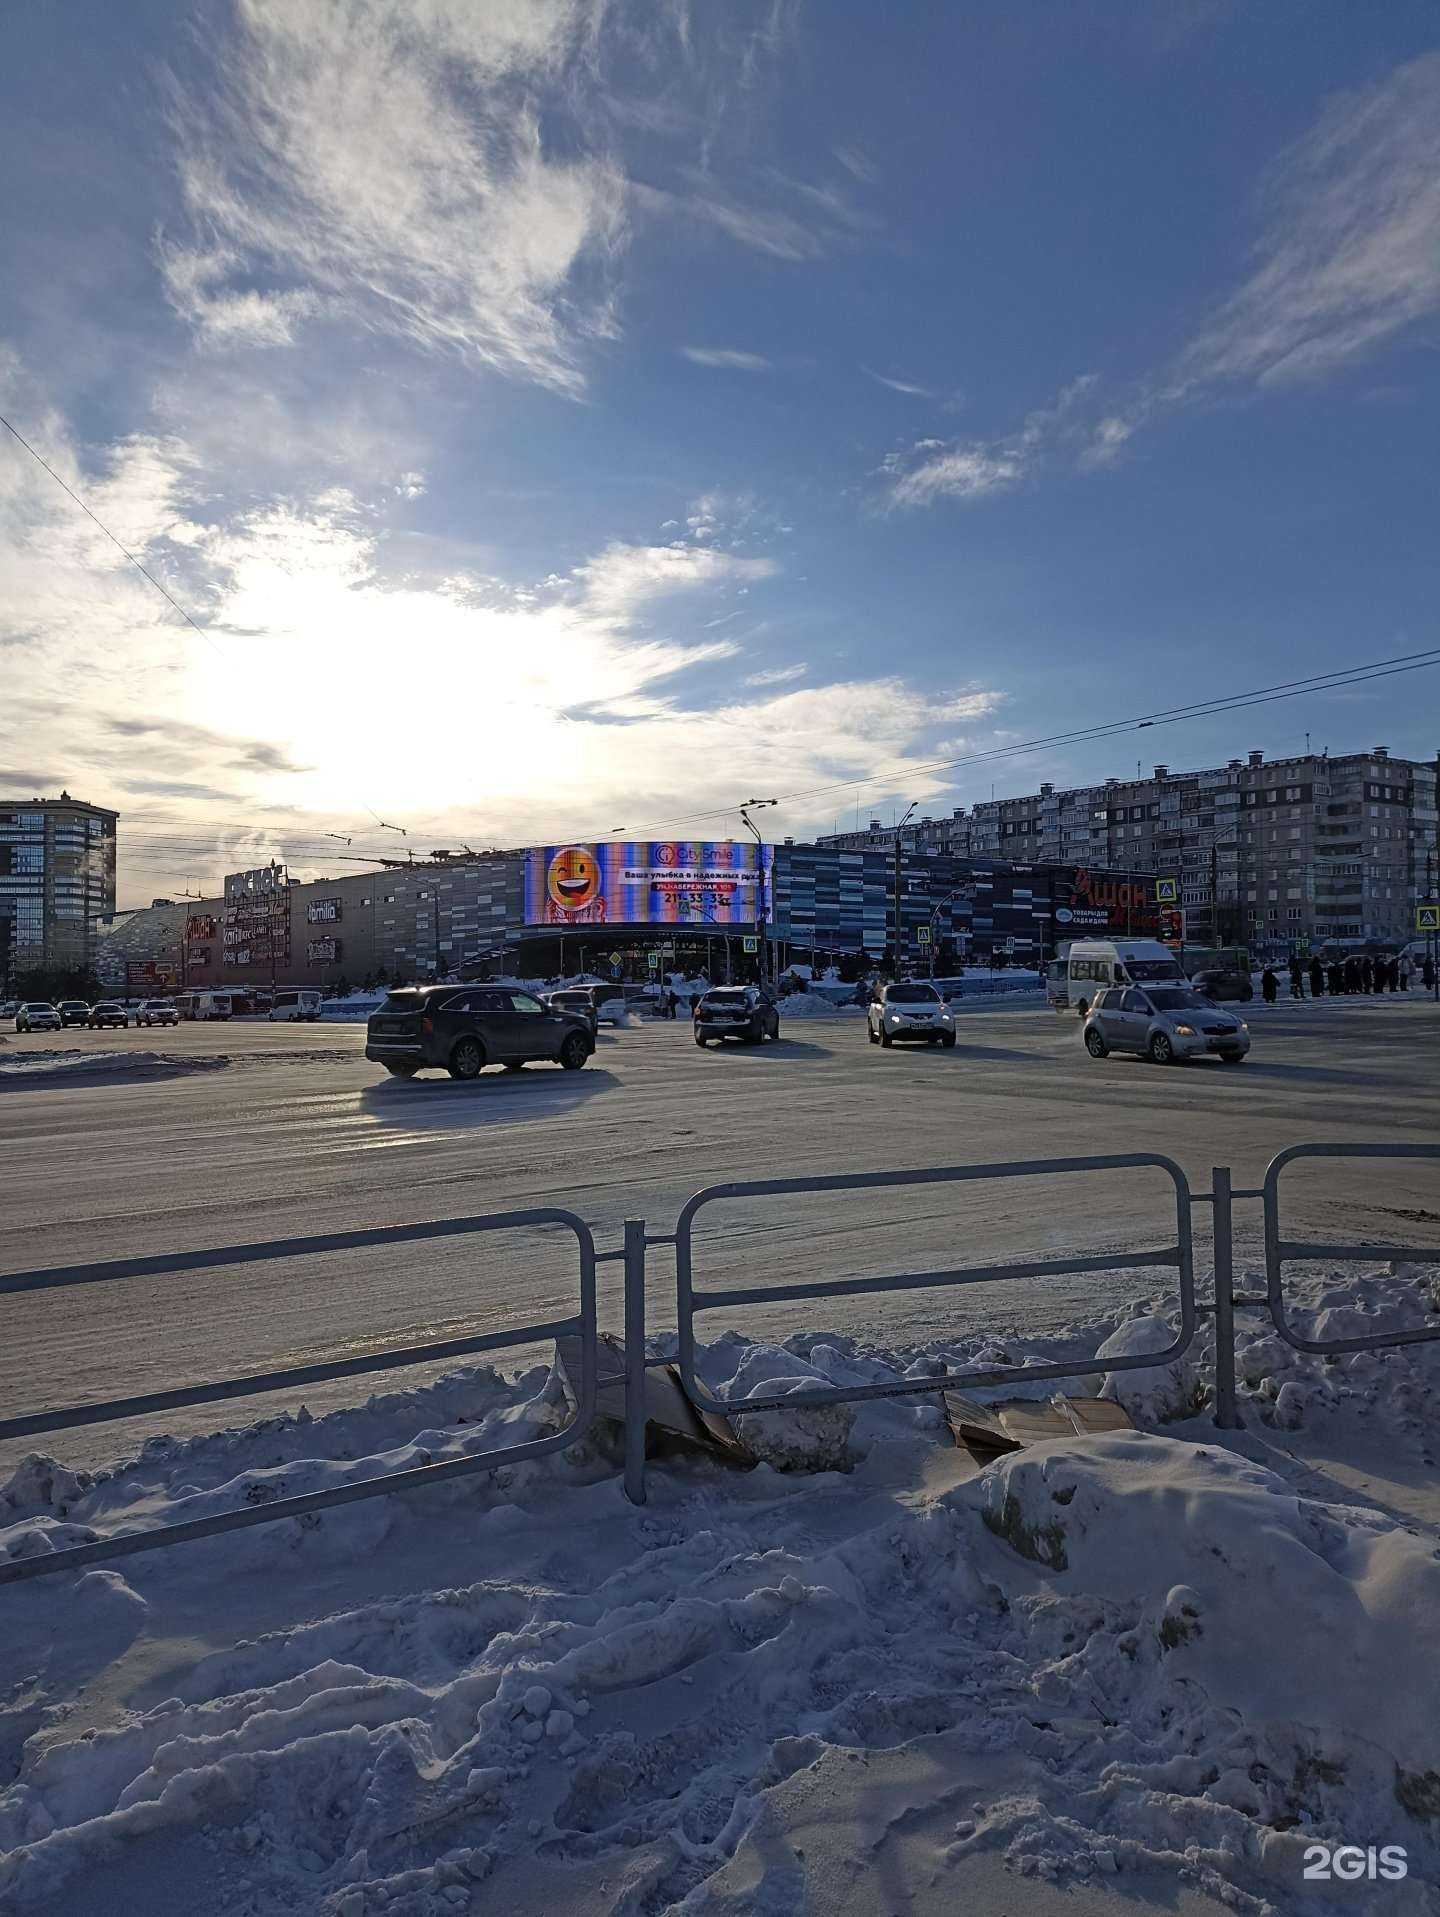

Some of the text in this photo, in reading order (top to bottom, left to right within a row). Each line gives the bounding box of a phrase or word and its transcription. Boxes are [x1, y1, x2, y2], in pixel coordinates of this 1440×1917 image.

[702, 849, 733, 860] Smile
[624, 871, 648, 879] Ваша
[650, 871, 684, 880] улыбка
[693, 872, 739, 880] надежных
[741, 872, 762, 881] рука
[664, 892, 724, 903] 211-33-33
[308, 903, 336, 922] familia
